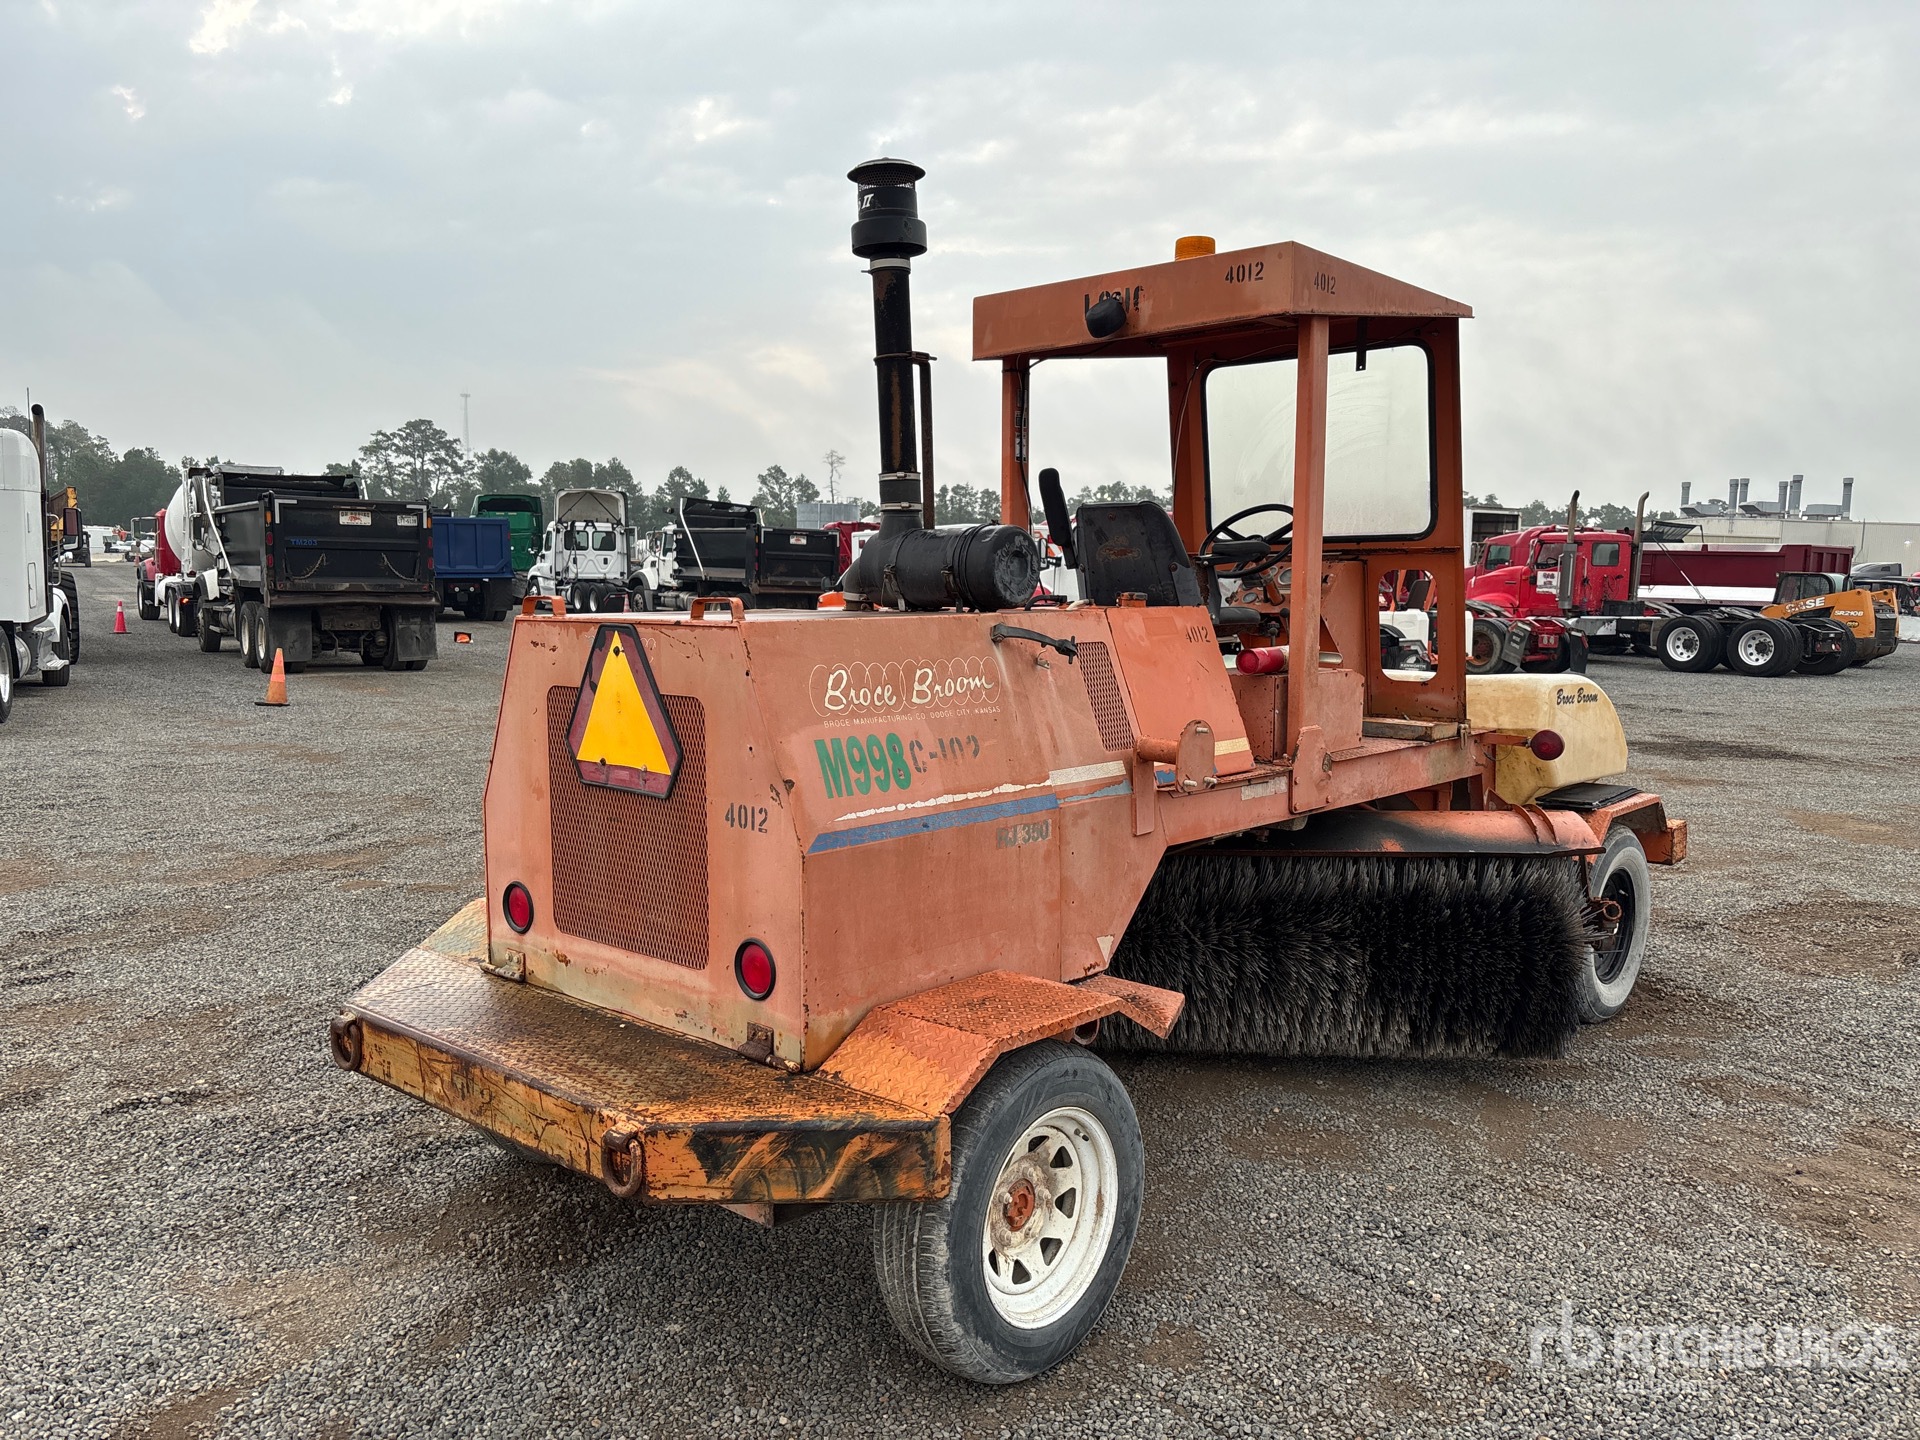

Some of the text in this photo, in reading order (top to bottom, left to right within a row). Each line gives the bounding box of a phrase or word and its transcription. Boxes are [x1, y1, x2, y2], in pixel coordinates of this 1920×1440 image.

[1225, 261, 1264, 284] 4012
[1314, 271, 1336, 295] 4012
[1785, 597, 1826, 613] CASE
[1185, 625, 1211, 643] 4012
[824, 667, 995, 711] Broce Broom
[1556, 687, 1599, 706] Broce Broom
[823, 718, 851, 728] BROCE
[853, 713, 913, 725] MANUFACTURING
[930, 709, 954, 719] DODGE
[975, 705, 1001, 714] KANSAS
[814, 732, 912, 799] M998
[724, 802, 768, 833] 4012
